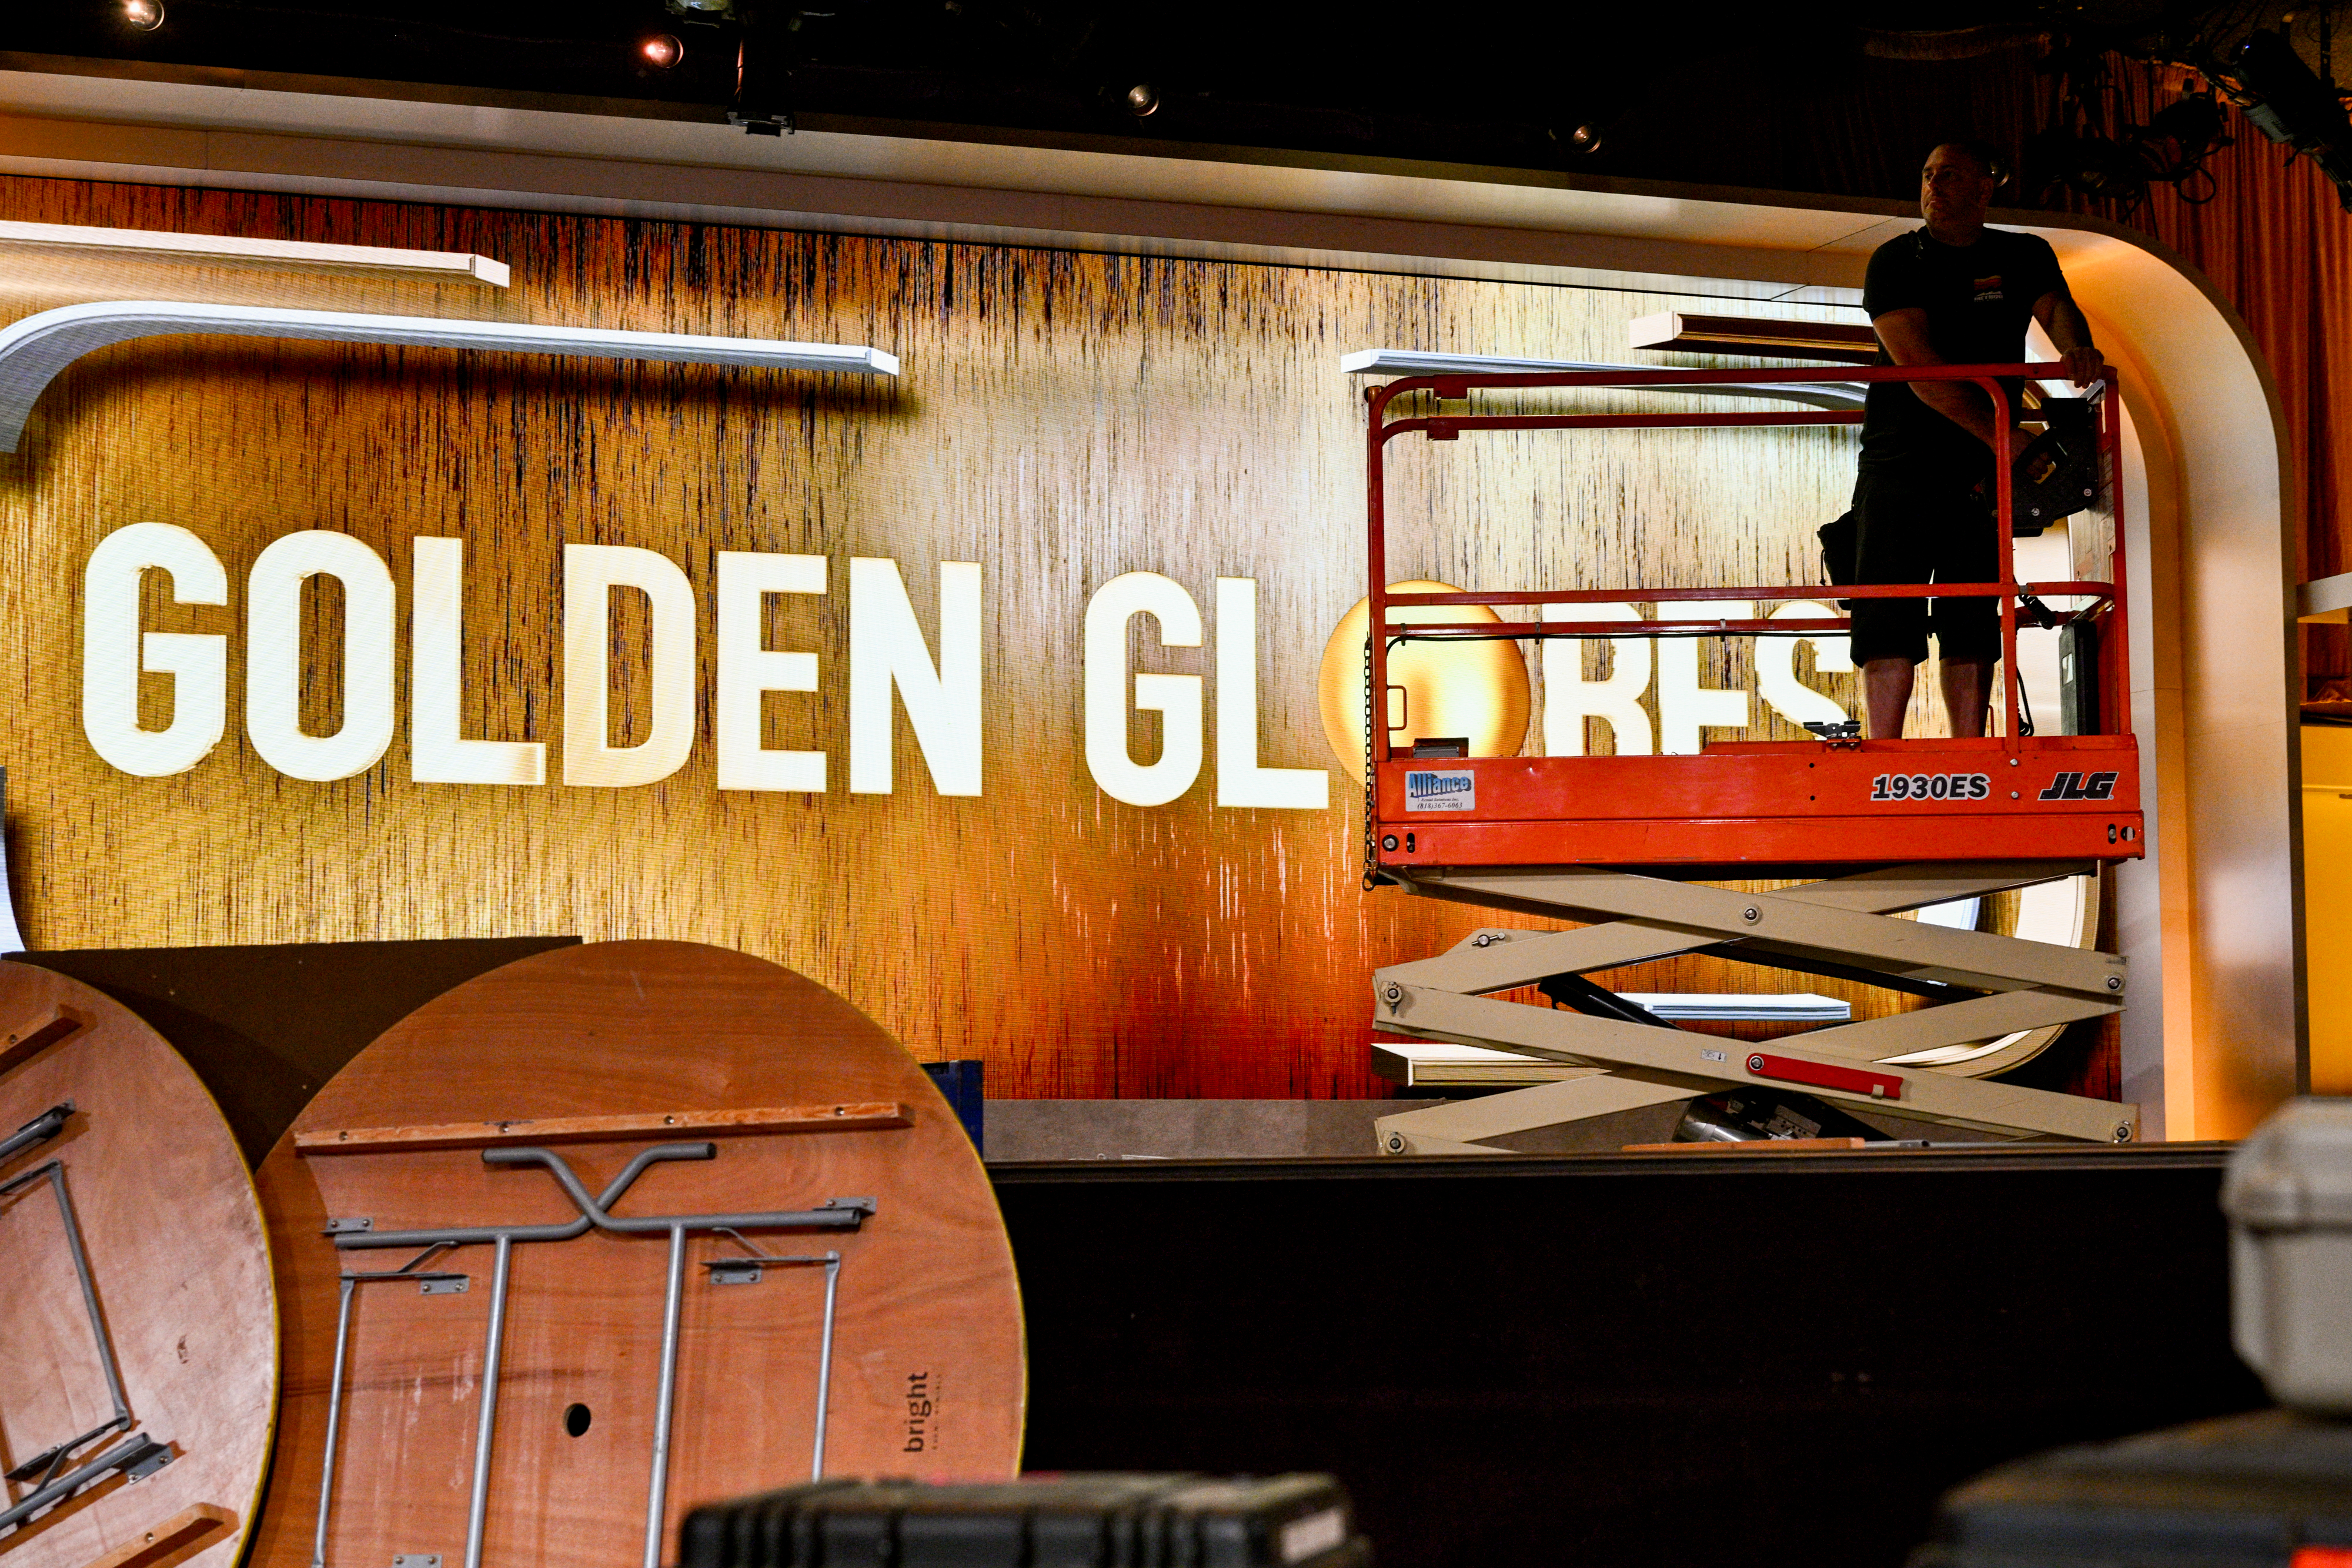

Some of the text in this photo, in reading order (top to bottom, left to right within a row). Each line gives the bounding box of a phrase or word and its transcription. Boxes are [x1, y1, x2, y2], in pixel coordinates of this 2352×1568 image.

[82, 521, 983, 797] GOLDEN
[1408, 773, 1471, 798] Alliance
[1870, 772, 2119, 801] 1930ES JLG
[903, 1372, 932, 1452] bright
